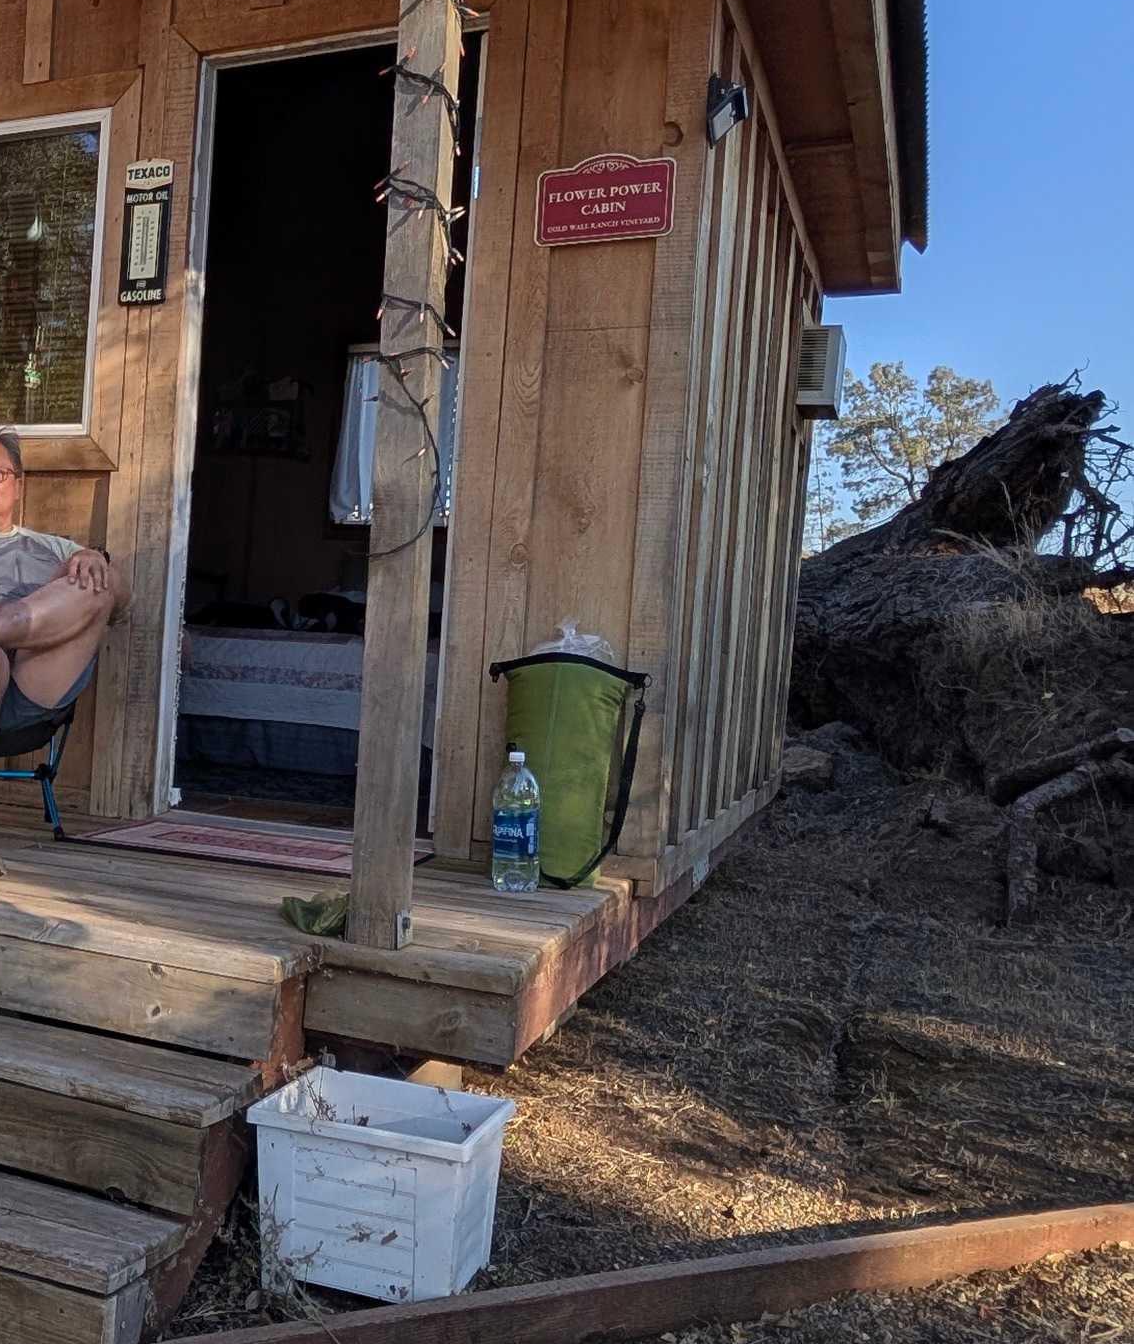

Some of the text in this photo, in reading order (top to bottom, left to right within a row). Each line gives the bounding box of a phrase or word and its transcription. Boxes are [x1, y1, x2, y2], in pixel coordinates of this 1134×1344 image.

[128, 165, 170, 180] TEXACO
[127, 190, 169, 204] MOTOR OIL
[548, 182, 663, 204] FLOWER POWER
[581, 201, 626, 216] CABIN
[591, 220, 619, 229] RANCH
[621, 216, 661, 227] VINEYARD
[121, 289, 162, 302] GASOLINE
